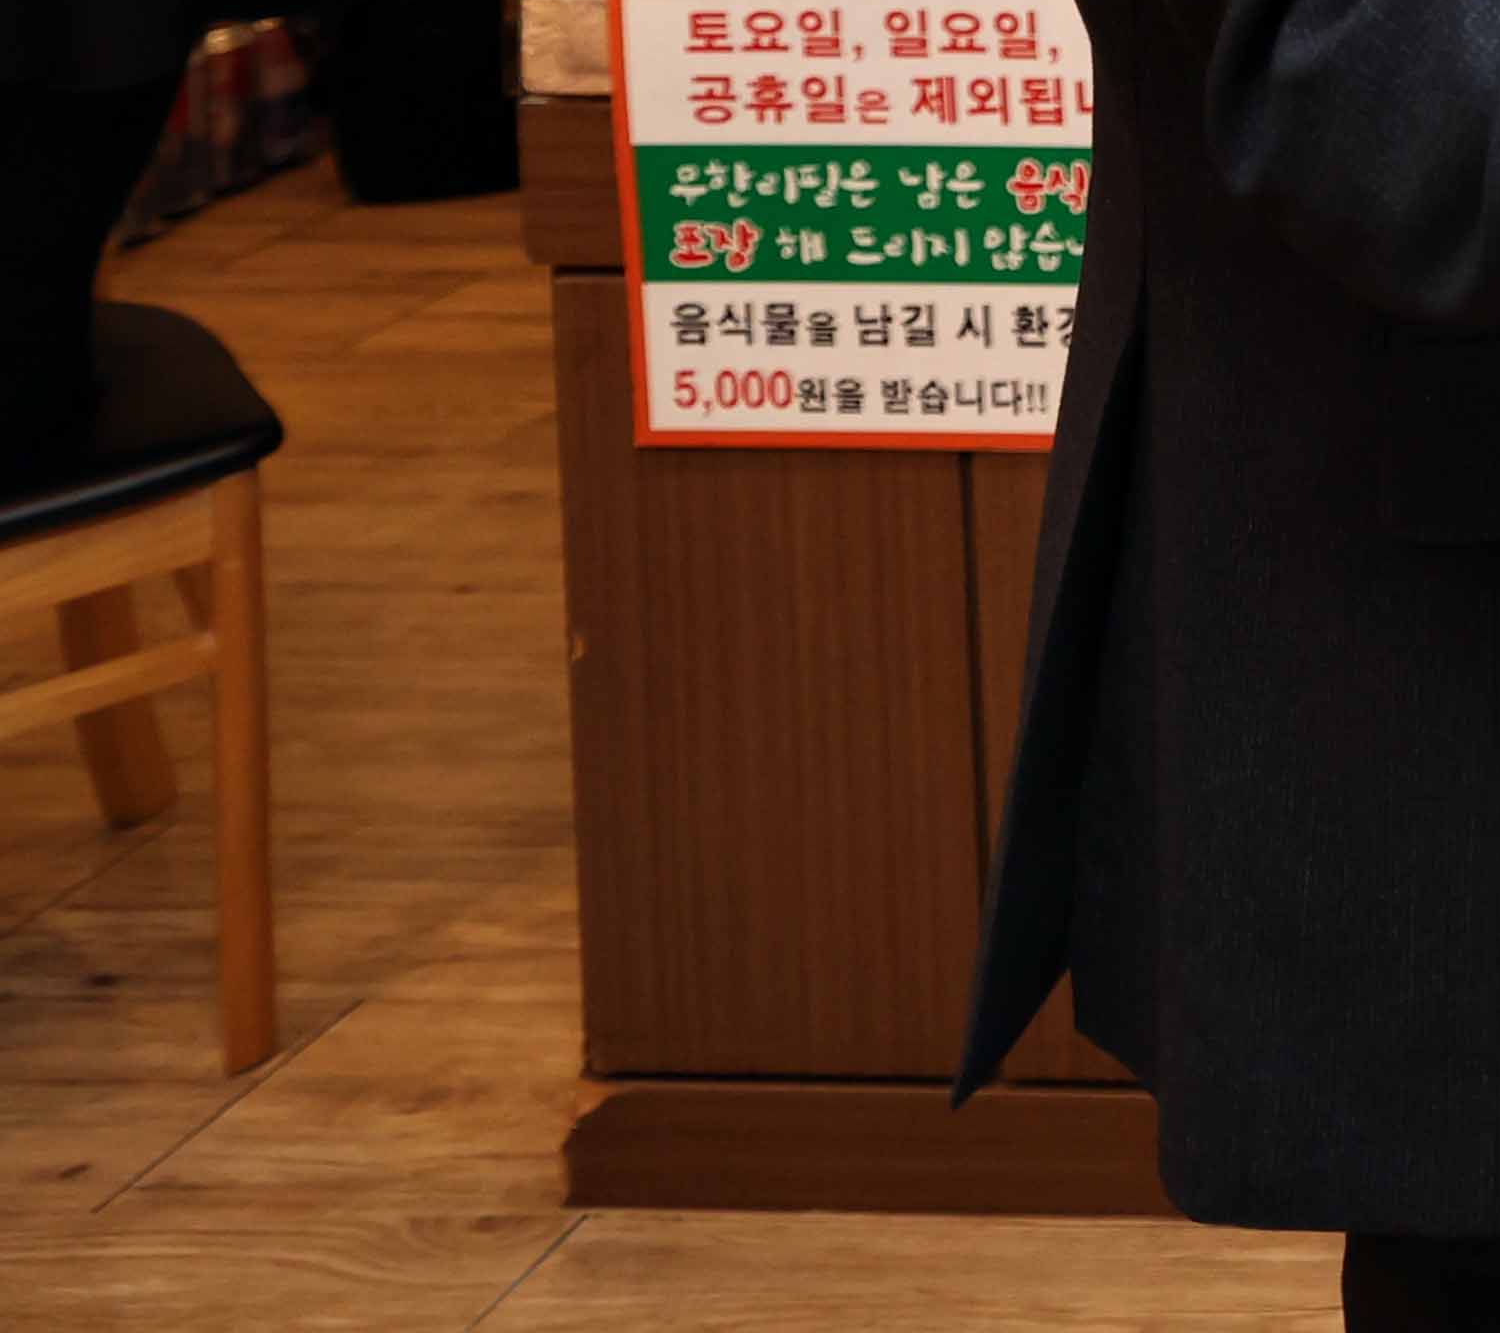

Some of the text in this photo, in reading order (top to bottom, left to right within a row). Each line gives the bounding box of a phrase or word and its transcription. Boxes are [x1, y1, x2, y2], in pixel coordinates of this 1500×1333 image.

[684, 9, 1060, 63] 토요일, 일요일,
[687, 75, 890, 124] 공휴일은
[669, 159, 880, 208] 무한리필은
[898, 160, 985, 210] 남은
[669, 217, 763, 272] 포장
[775, 227, 827, 264] 해
[846, 226, 971, 266] 드리지
[670, 301, 838, 347] 음식물을
[853, 303, 937, 348] 남길
[956, 304, 991, 348] 시
[673, 370, 1049, 416] 5,000원을 받습니다!!
